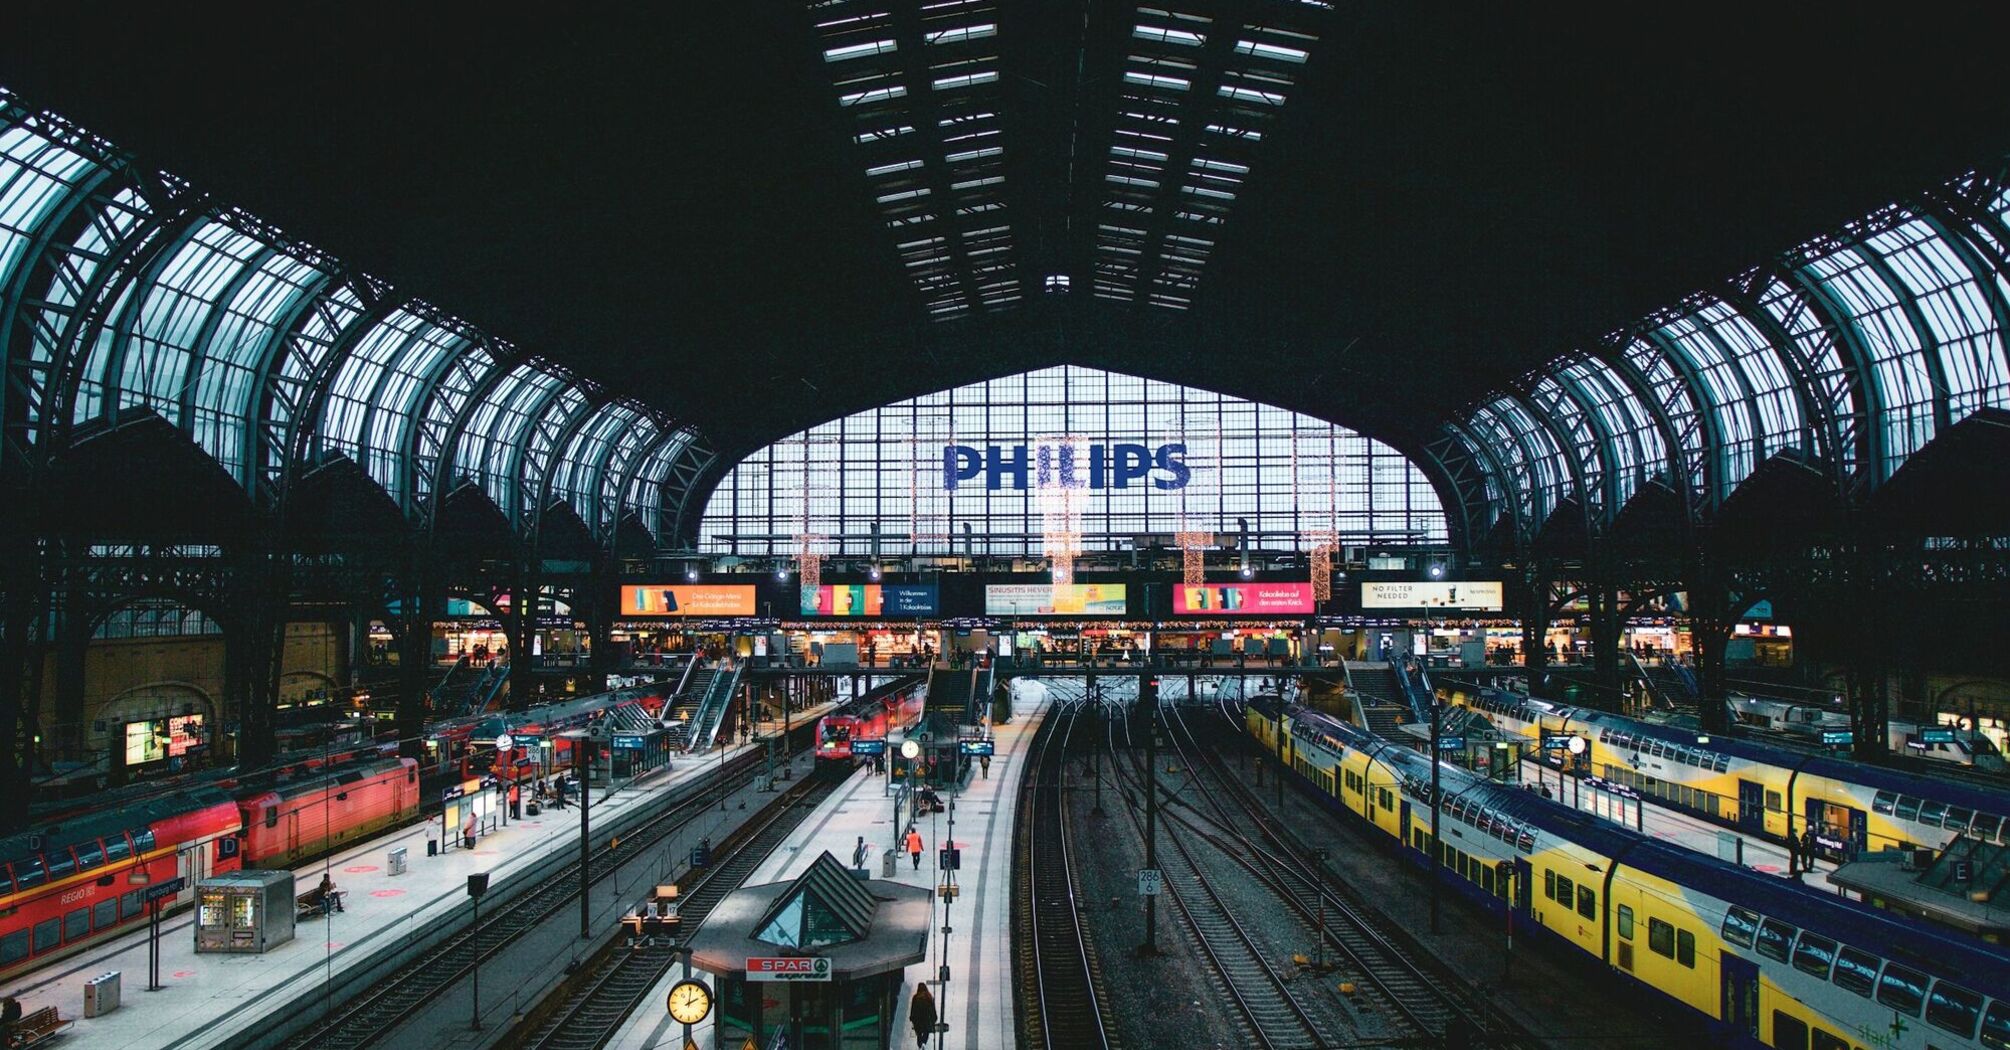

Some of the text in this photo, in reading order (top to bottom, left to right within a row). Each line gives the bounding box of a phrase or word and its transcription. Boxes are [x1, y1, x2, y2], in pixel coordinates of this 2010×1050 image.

[943, 443, 1191, 490] PHILIPS
[988, 586, 1025, 594] SINUSITIS
[30, 835, 41, 850] D
[224, 838, 236, 854] D
[693, 849, 703, 866] E
[1140, 870, 1160, 882] 286
[1957, 863, 1967, 880] E
[1145, 881, 1154, 892] 6
[61, 888, 85, 905] REGIO
[761, 960, 811, 971] SPAR
[775, 972, 828, 981] express
